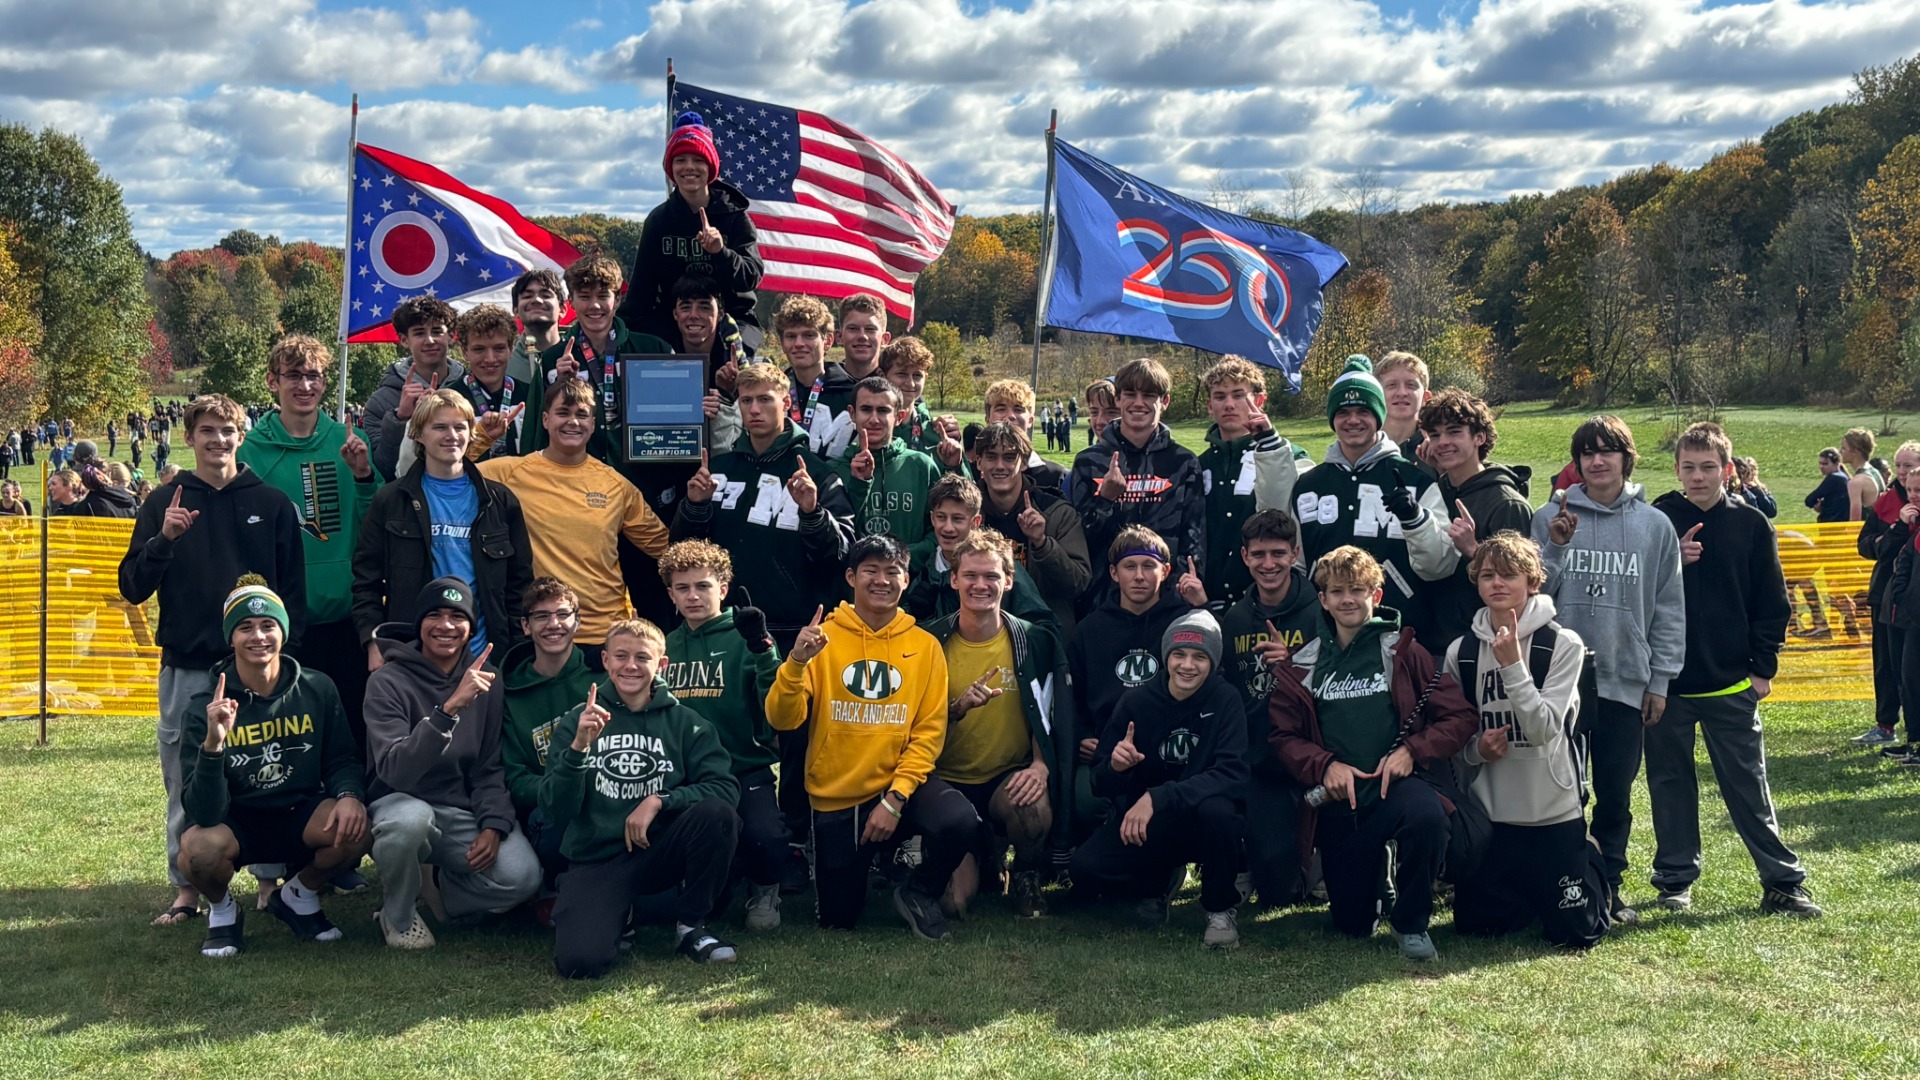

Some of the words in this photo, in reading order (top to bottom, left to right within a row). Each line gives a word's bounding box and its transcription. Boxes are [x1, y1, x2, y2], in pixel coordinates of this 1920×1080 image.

[313, 461, 342, 534] MEDINA
[747, 473, 800, 531] M
[1353, 483, 1417, 540] M
[845, 659, 899, 699] M
[1313, 671, 1370, 699] Medina
[1326, 690, 1346, 700] CROSS
[1347, 688, 1373, 698] COUNTRY
[831, 700, 861, 722] TRACK
[862, 703, 883, 724] AND
[883, 703, 907, 724] FIELD
[226, 714, 314, 747] MEDINA
[260, 742, 282, 764] XC
[598, 734, 665, 756] MEDINA
[658, 760, 674, 772] 23
[595, 772, 619, 799] CROSS
[622, 773, 664, 799] COUNTRY
[1559, 876, 1582, 887] Cross
[1559, 897, 1589, 909] Country
